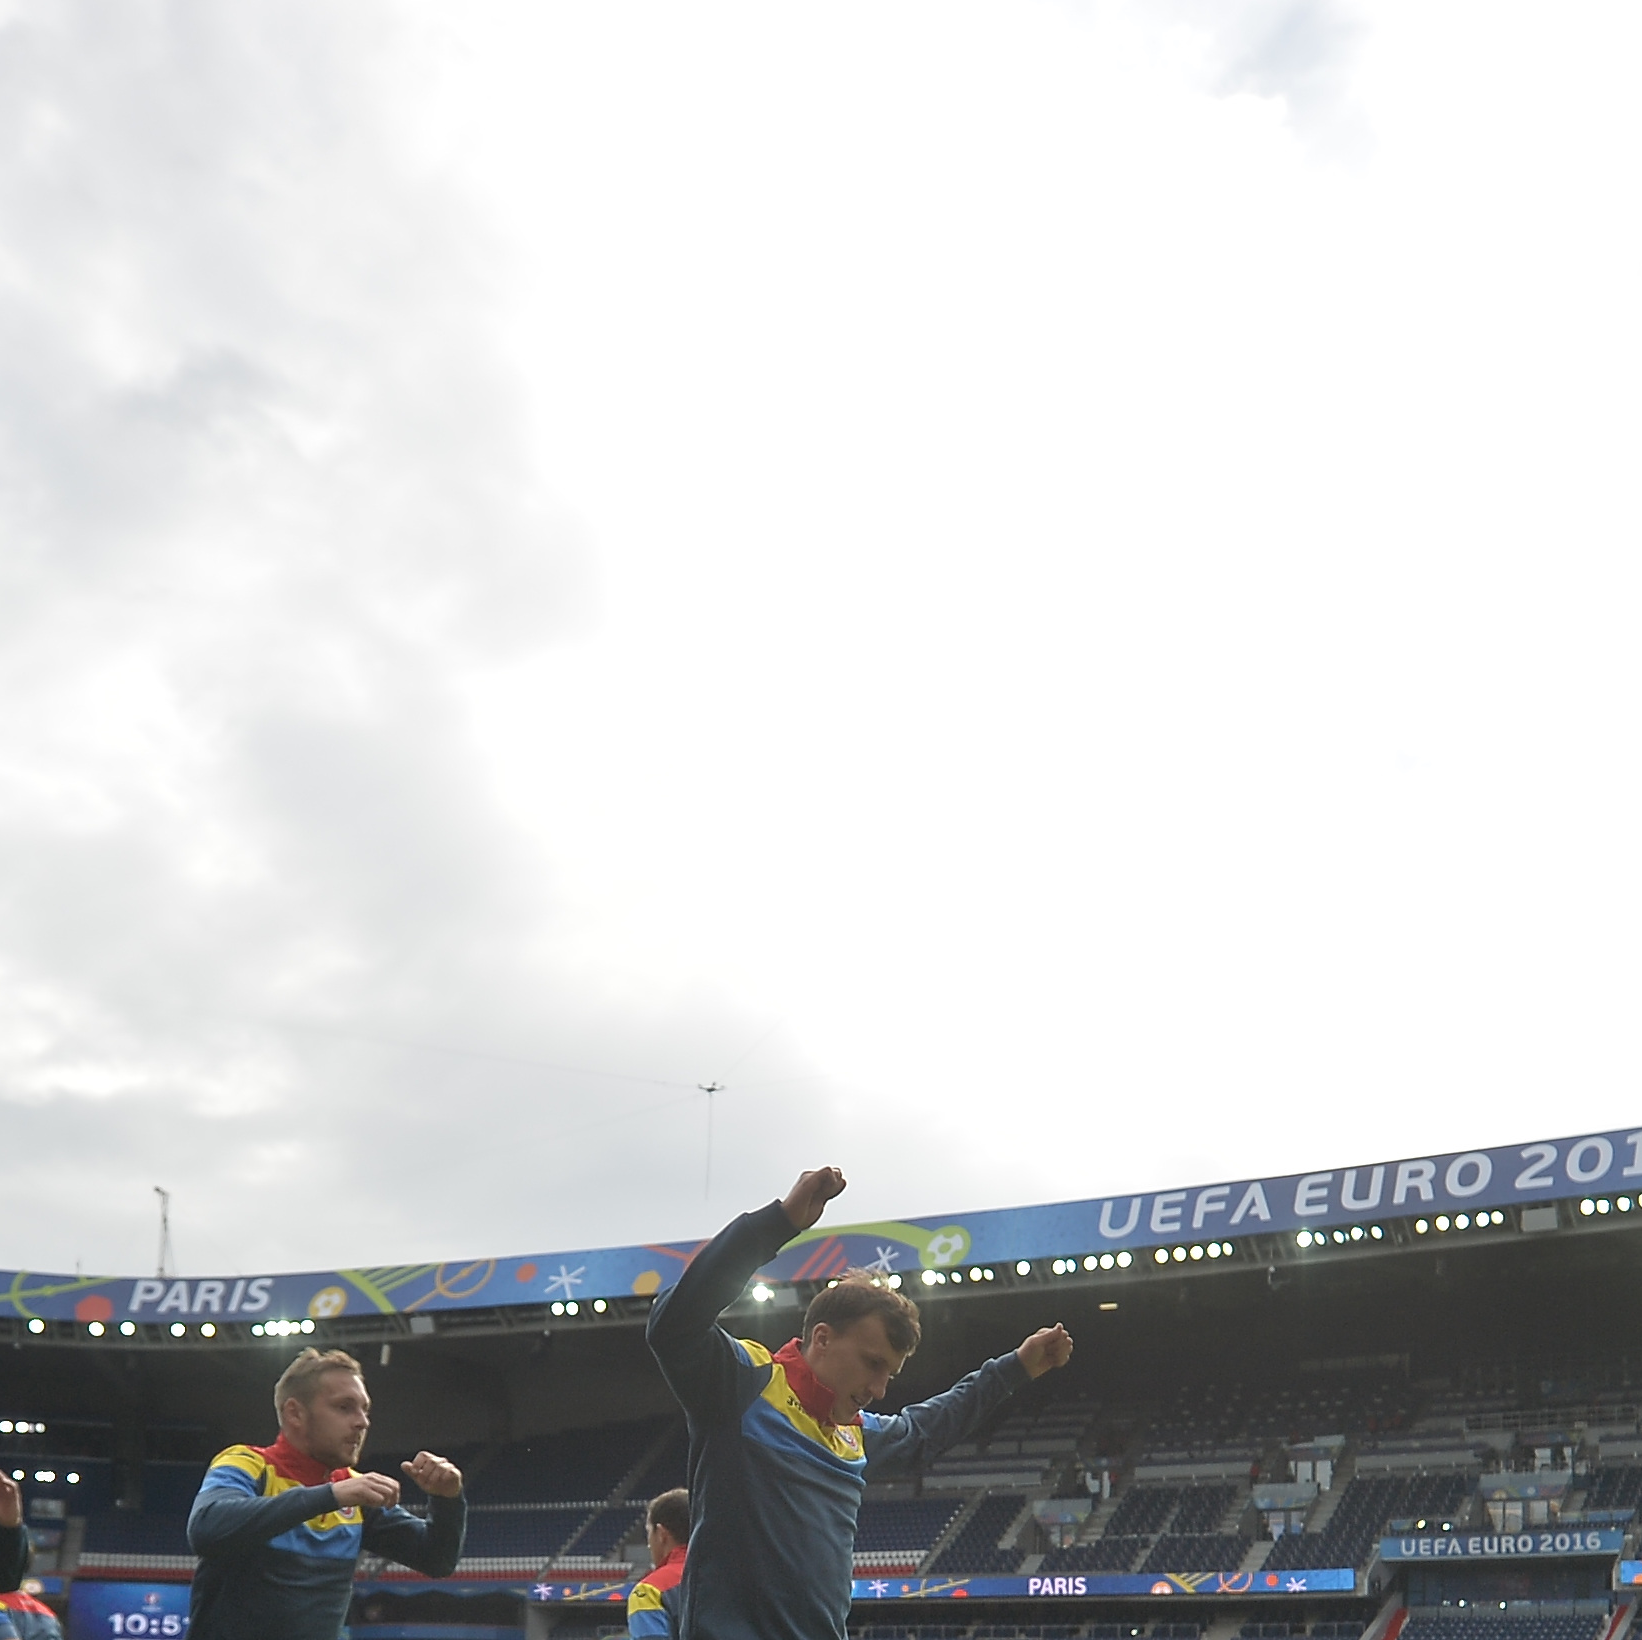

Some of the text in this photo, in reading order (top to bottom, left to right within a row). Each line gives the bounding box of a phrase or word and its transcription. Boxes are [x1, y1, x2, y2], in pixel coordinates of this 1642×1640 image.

[1097, 1183, 1272, 1239] UEFA
[1293, 1152, 1494, 1218] EURO
[127, 1278, 275, 1314] PARIS
[1400, 1532, 1602, 1556] UEFA EURO 2016
[1028, 1576, 1088, 1596] PARIS
